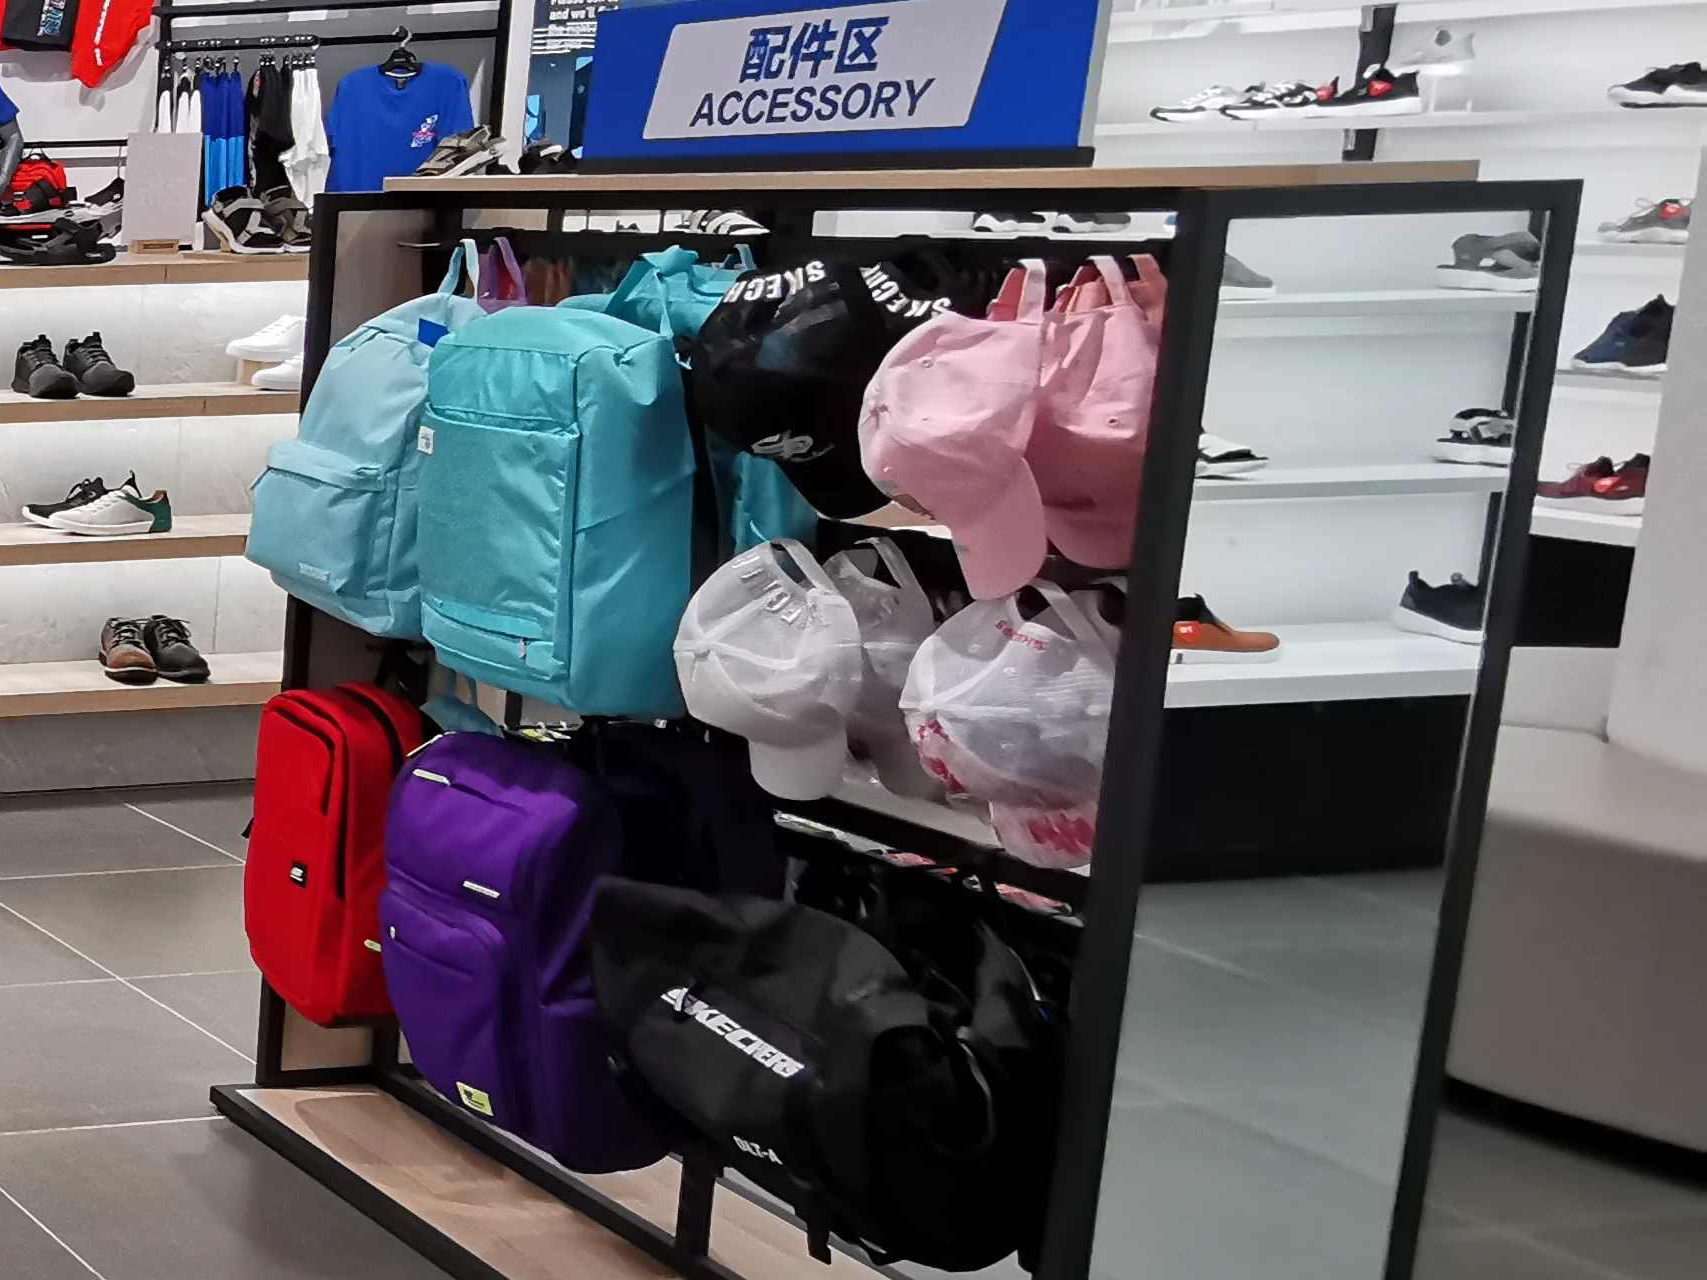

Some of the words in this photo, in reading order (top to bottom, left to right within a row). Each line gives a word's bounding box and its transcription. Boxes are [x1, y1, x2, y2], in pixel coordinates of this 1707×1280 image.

[739, 16, 890, 84] 配件区
[689, 78, 935, 127] ACCESSORY
[660, 987, 805, 1078] SKECHERS
